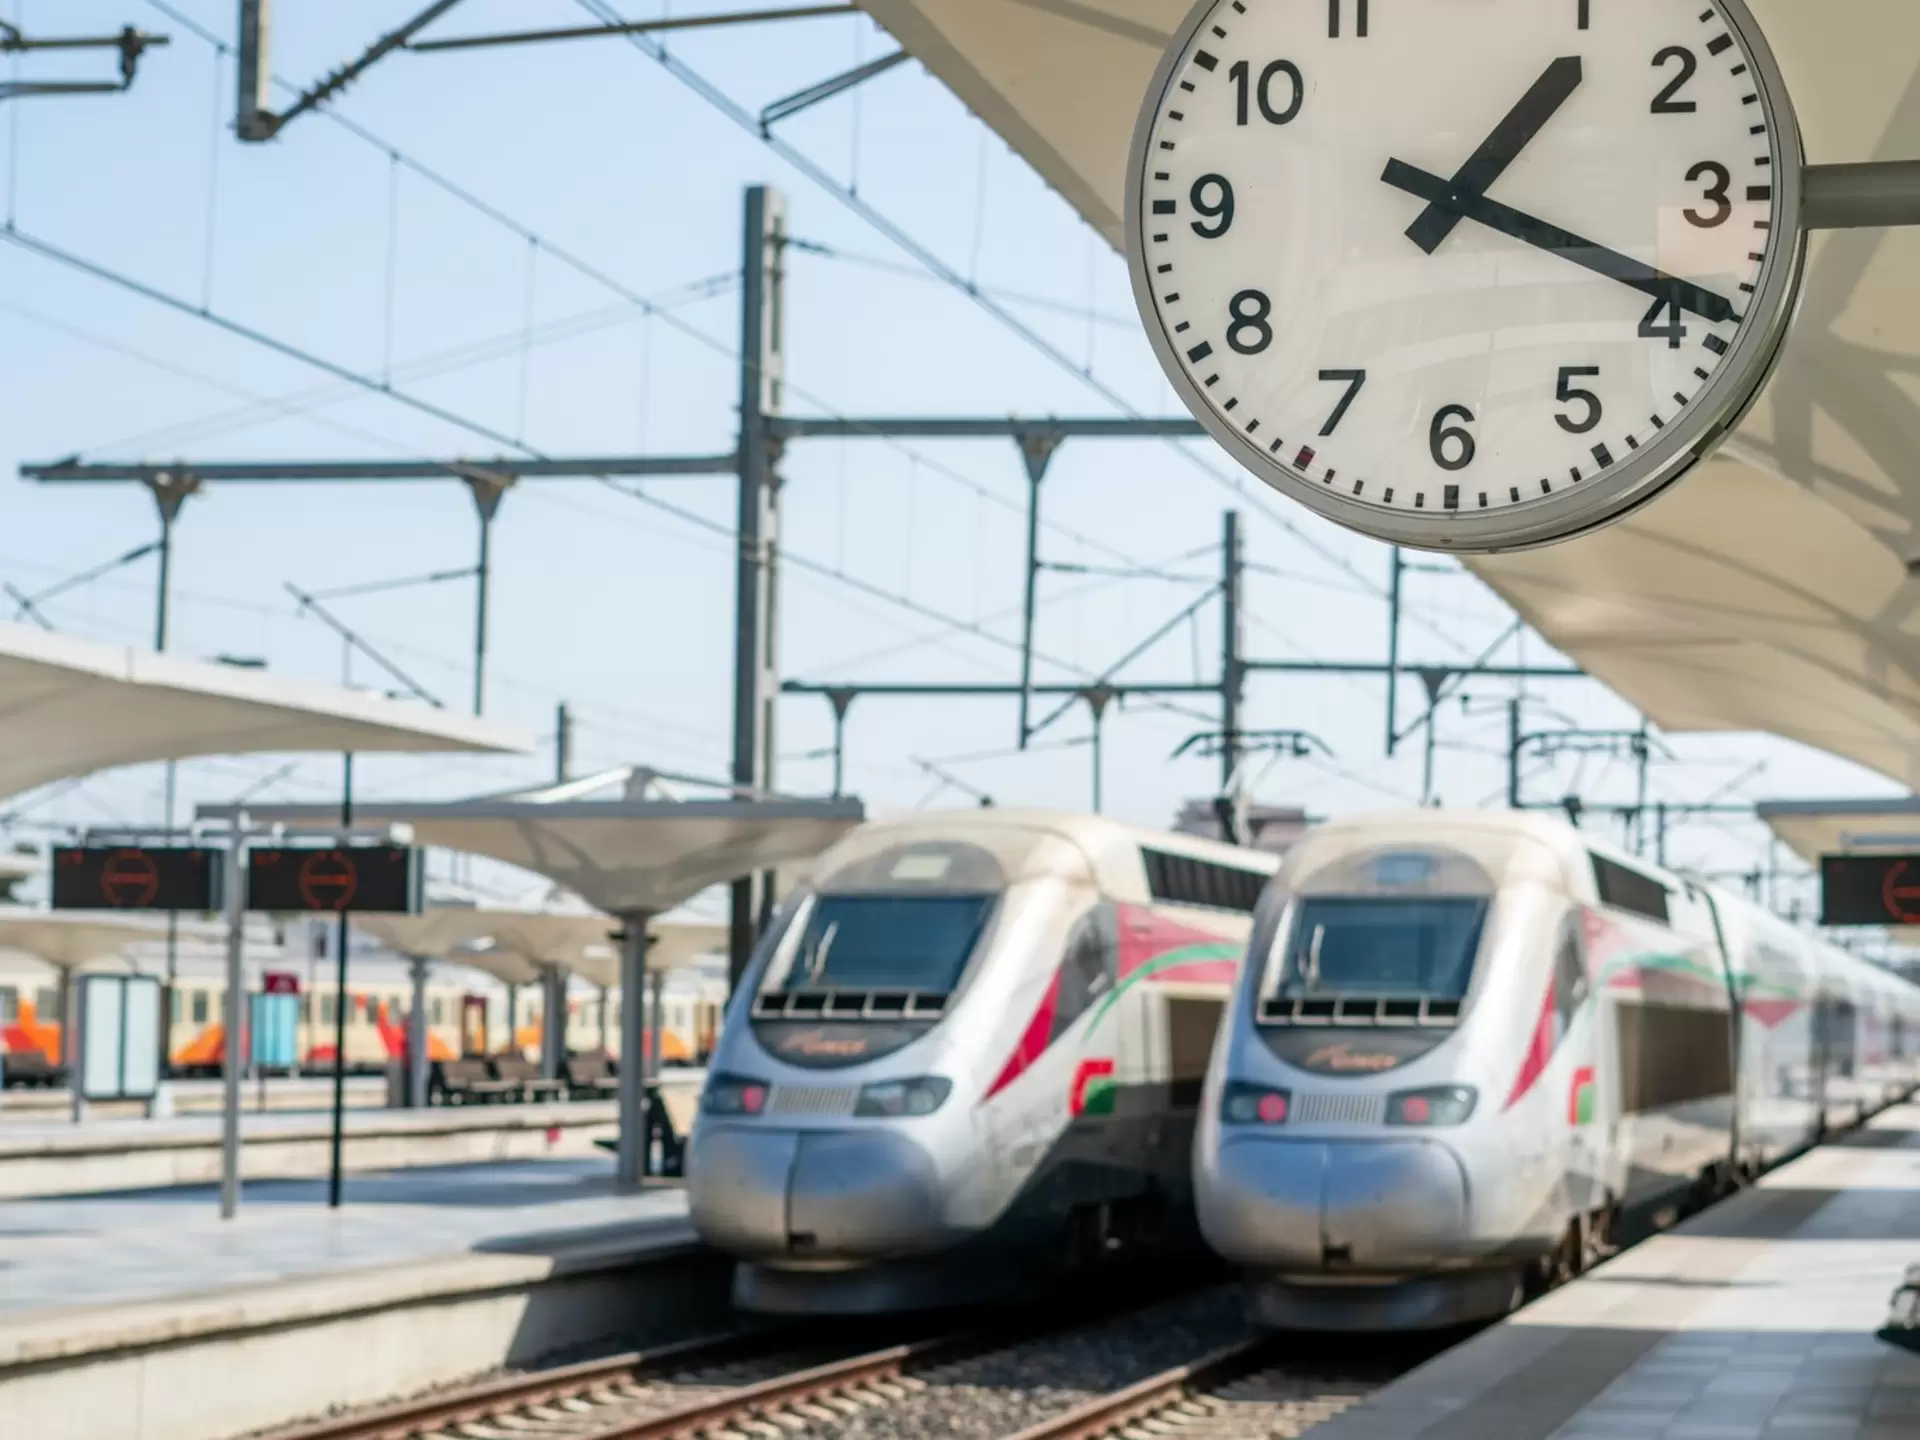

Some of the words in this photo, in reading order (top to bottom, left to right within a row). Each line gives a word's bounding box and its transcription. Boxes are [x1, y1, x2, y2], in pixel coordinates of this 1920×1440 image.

[1228, 59, 1304, 126] 10
[1649, 46, 1697, 114] 2
[1189, 173, 1235, 239] 9
[1682, 161, 1732, 228] 3
[1226, 289, 1273, 355] 8
[1637, 295, 1687, 349] 4
[1317, 369, 1366, 436] 7
[1554, 366, 1603, 433] 5
[1429, 404, 1476, 470] 6
